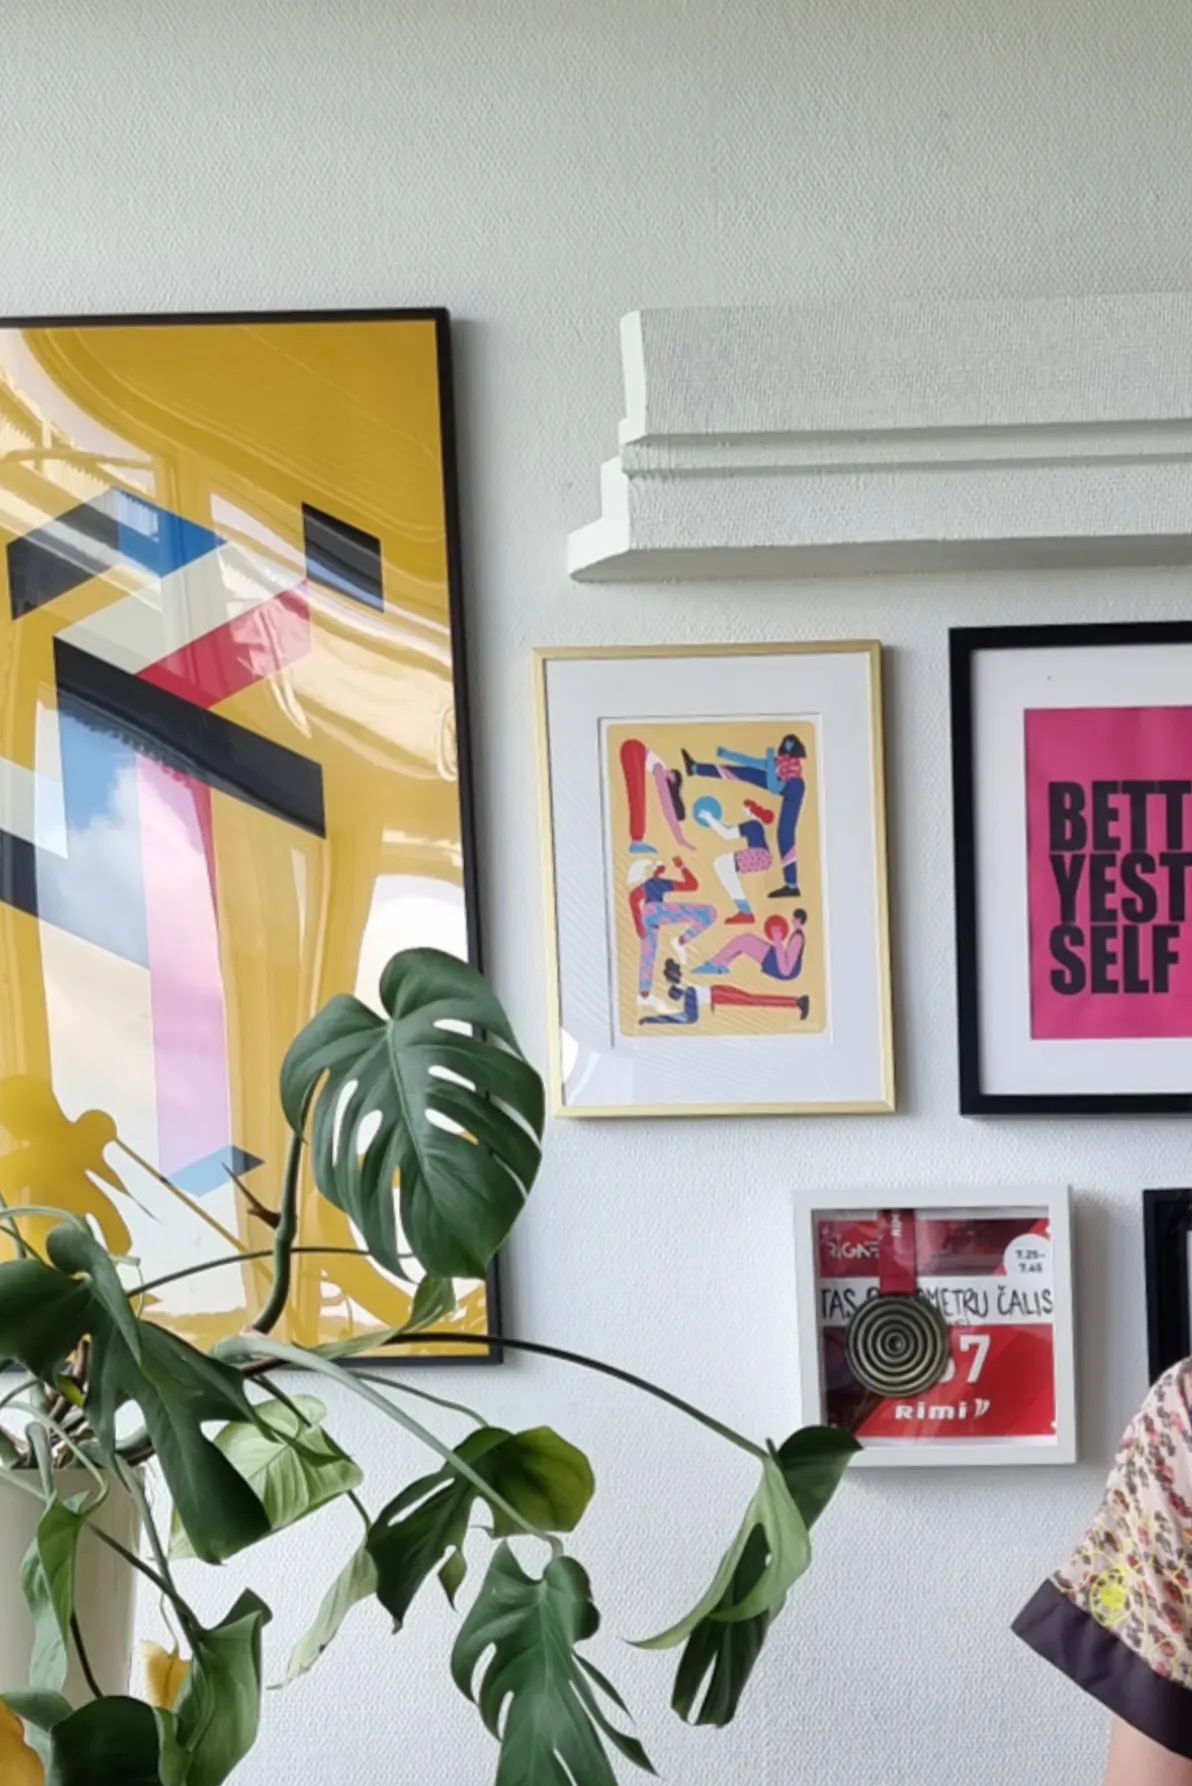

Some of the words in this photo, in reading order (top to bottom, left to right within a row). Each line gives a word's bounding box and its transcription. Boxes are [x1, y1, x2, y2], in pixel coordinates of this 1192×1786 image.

[1049, 924, 1180, 995] SELF
[917, 1287, 989, 1317] METRU
[996, 1284, 1053, 1317] ČALIS
